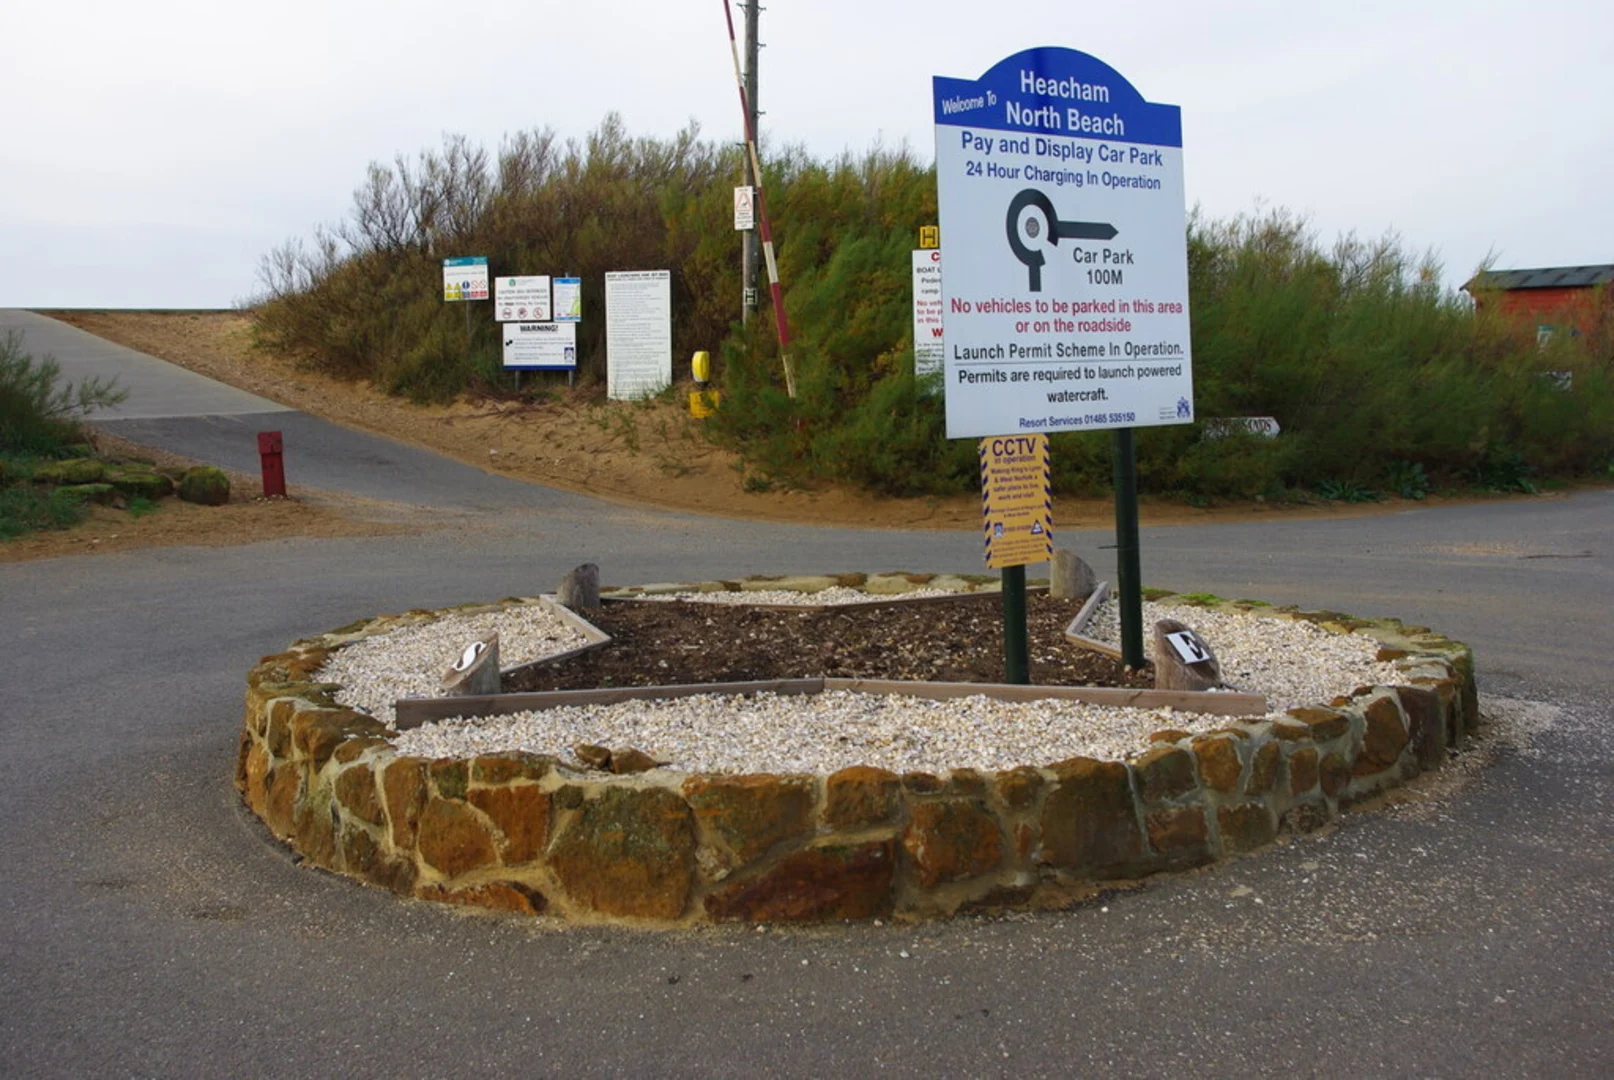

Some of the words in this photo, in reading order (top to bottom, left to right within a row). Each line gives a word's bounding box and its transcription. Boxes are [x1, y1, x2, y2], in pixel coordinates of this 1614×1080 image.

[1020, 69, 1109, 102] Heacham
[942, 95, 984, 115] Welcome
[986, 89, 997, 106] To
[1006, 101, 1061, 129] North
[1067, 107, 1125, 136] Beach
[962, 131, 994, 155] Pay
[999, 136, 1030, 155] and
[1036, 138, 1093, 164] Display
[1098, 144, 1124, 163] Car
[1130, 147, 1163, 166] Park
[966, 160, 983, 176] 24
[987, 162, 1020, 179] Hour
[1024, 165, 1084, 190] Charging
[1087, 170, 1098, 186] In
[1102, 172, 1161, 191] Operation
[1073, 247, 1098, 264] Car
[1103, 248, 1134, 265] Park
[1086, 269, 1123, 285] 100M
[951, 298, 972, 314] No
[975, 298, 1030, 314] vehicles
[1036, 300, 1048, 314] to
[1052, 299, 1069, 314] be
[1072, 299, 1116, 318] parked
[1119, 300, 1130, 314] in
[1133, 300, 1155, 314] this
[1157, 302, 1183, 314] area
[1015, 320, 1030, 333] or
[1033, 320, 1051, 333] on
[1053, 318, 1074, 333] the
[1077, 317, 1131, 333] roadside
[954, 344, 1005, 360] Launch
[1009, 343, 1053, 359] Permit
[1056, 342, 1106, 358] Scheme
[1109, 342, 1121, 357] In
[1124, 341, 1184, 359] Operation.
[959, 368, 1007, 384] Permits
[1010, 371, 1030, 383] are
[1033, 368, 1081, 384] required
[1084, 368, 1096, 380] to
[1098, 366, 1134, 379] launch
[1137, 364, 1182, 381] powered
[1047, 387, 1109, 404] watercraft.
[1019, 417, 1047, 428] Resort
[1049, 415, 1083, 426] Services
[992, 437, 1036, 456] CCTV
[1003, 455, 1036, 464] operation
